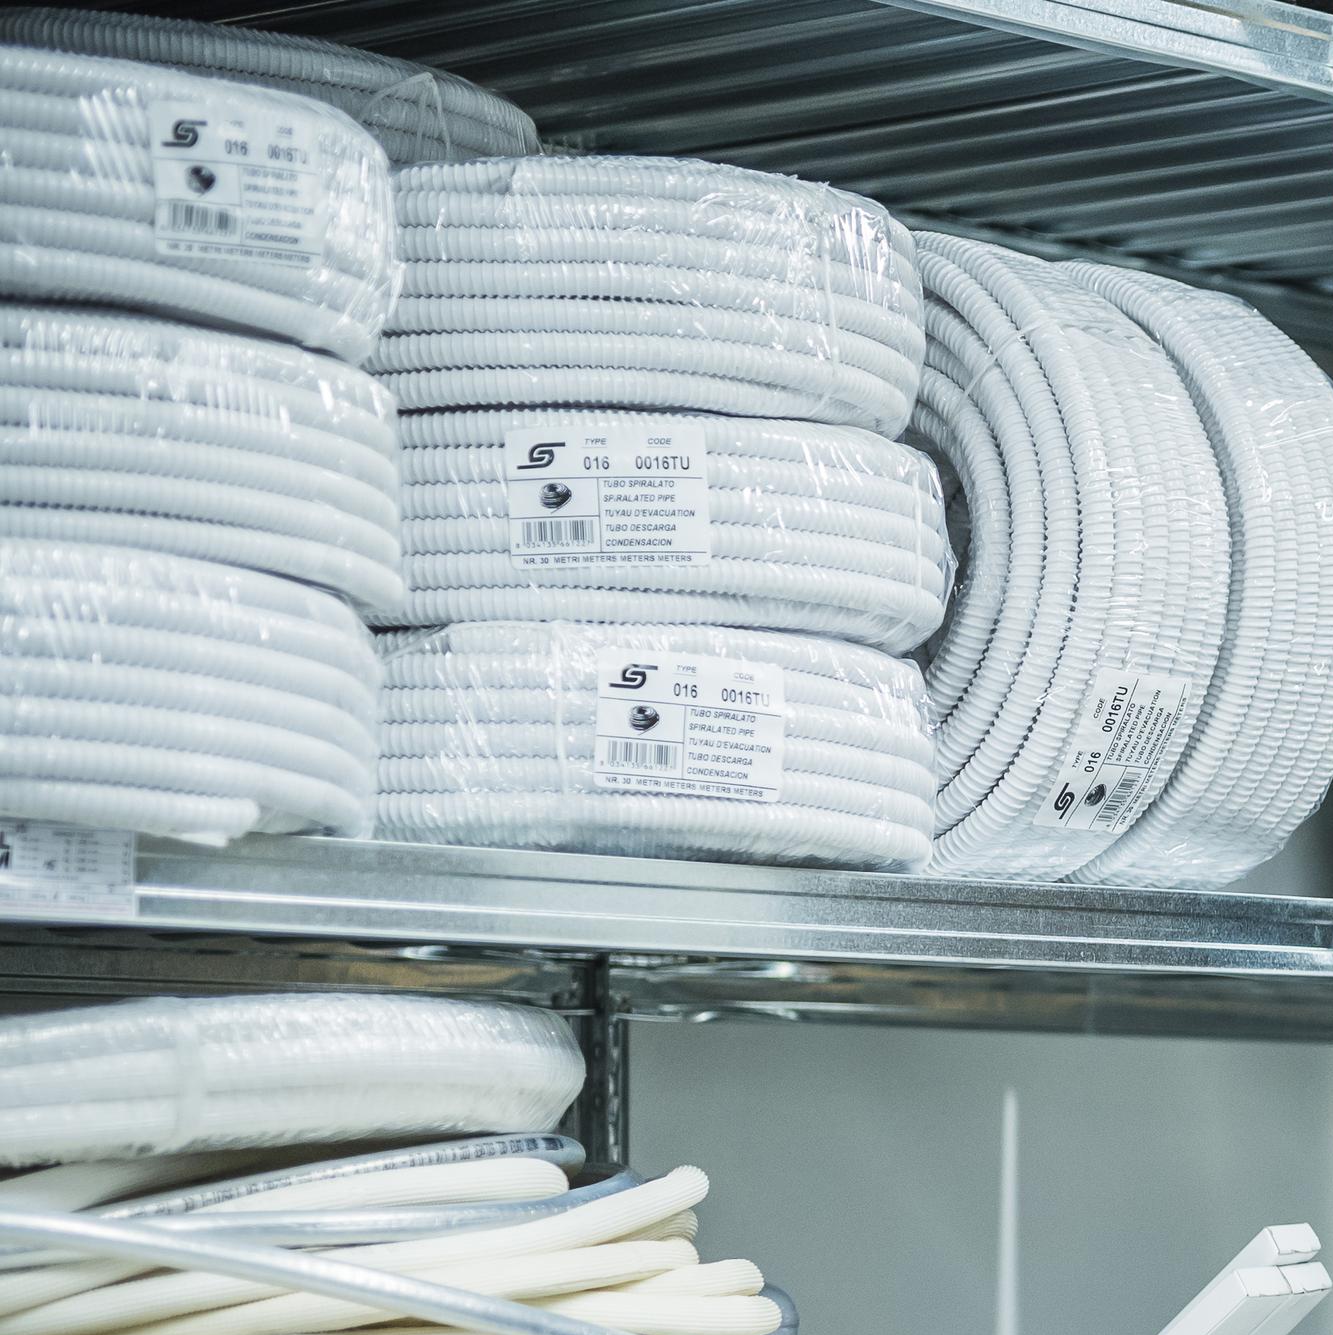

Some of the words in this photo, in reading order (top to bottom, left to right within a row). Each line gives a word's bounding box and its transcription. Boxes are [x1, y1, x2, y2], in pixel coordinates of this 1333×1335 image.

[224, 139, 248, 156] 016
[584, 437, 607, 446] TYPE
[647, 437, 673, 446] CODE
[583, 456, 610, 470] 016
[635, 455, 690, 471] 0016TU
[603, 480, 626, 488] TUBO
[628, 480, 675, 489] SPIRALATO
[603, 494, 656, 503] SPIRALATED
[657, 494, 676, 503] PIPE
[604, 509, 632, 518] TUYAU
[605, 524, 629, 532] TUBO
[630, 524, 677, 532] DESCARGA
[605, 538, 672, 547] CONDENSACION
[676, 664, 697, 674] TYPE
[673, 682, 698, 698] 016
[721, 688, 770, 707] 0016TU
[690, 708, 712, 718] TUBO
[713, 711, 756, 723] SPIRALATO
[1093, 698, 1105, 719] CODE
[1102, 686, 1129, 733] 0016TU
[1135, 704, 1146, 721] PIPE
[1107, 741, 1119, 761] TUBO
[1115, 703, 1136, 741] SPIRALATO
[1143, 712, 1172, 765] CONDENSACION
[710, 754, 753, 766] DESCARGA
[1071, 751, 1083, 768] TYPE
[1084, 751, 1102, 773] 016
[687, 767, 748, 779] CONDENSACION
